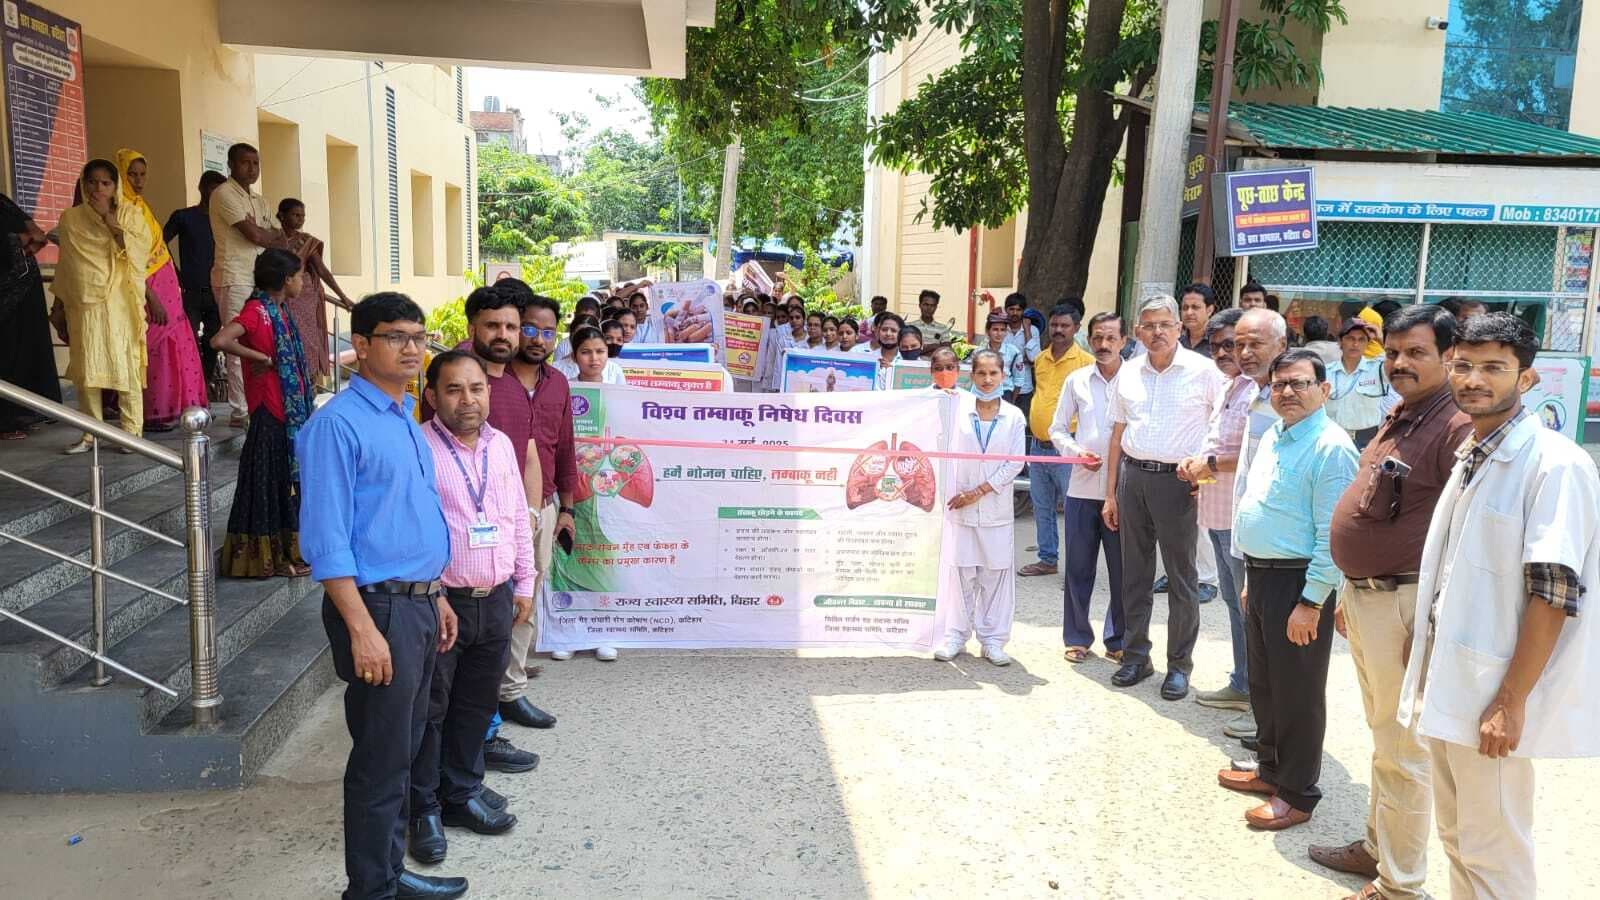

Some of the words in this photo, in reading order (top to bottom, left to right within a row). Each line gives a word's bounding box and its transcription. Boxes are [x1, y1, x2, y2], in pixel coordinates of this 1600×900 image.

[1337, 201, 1353, 213] में
[1354, 203, 1403, 215] सहयोग
[1407, 203, 1421, 215] के
[1426, 203, 1452, 216] लिए
[1456, 207, 1488, 217] पहल
[1502, 206, 1531, 220] Mob
[1543, 207, 1600, 222] 8340171
[642, 402, 687, 420] विश्व
[693, 405, 755, 427] तम्बाकू
[758, 404, 809, 422] निषेध
[814, 405, 863, 424] दिवस
[771, 469, 814, 484] तम्बाकू
[615, 598, 641, 607] राज्य
[645, 597, 684, 607] स्वास्थ्य
[687, 594, 727, 606] समिति,
[731, 594, 761, 606] बिहार
